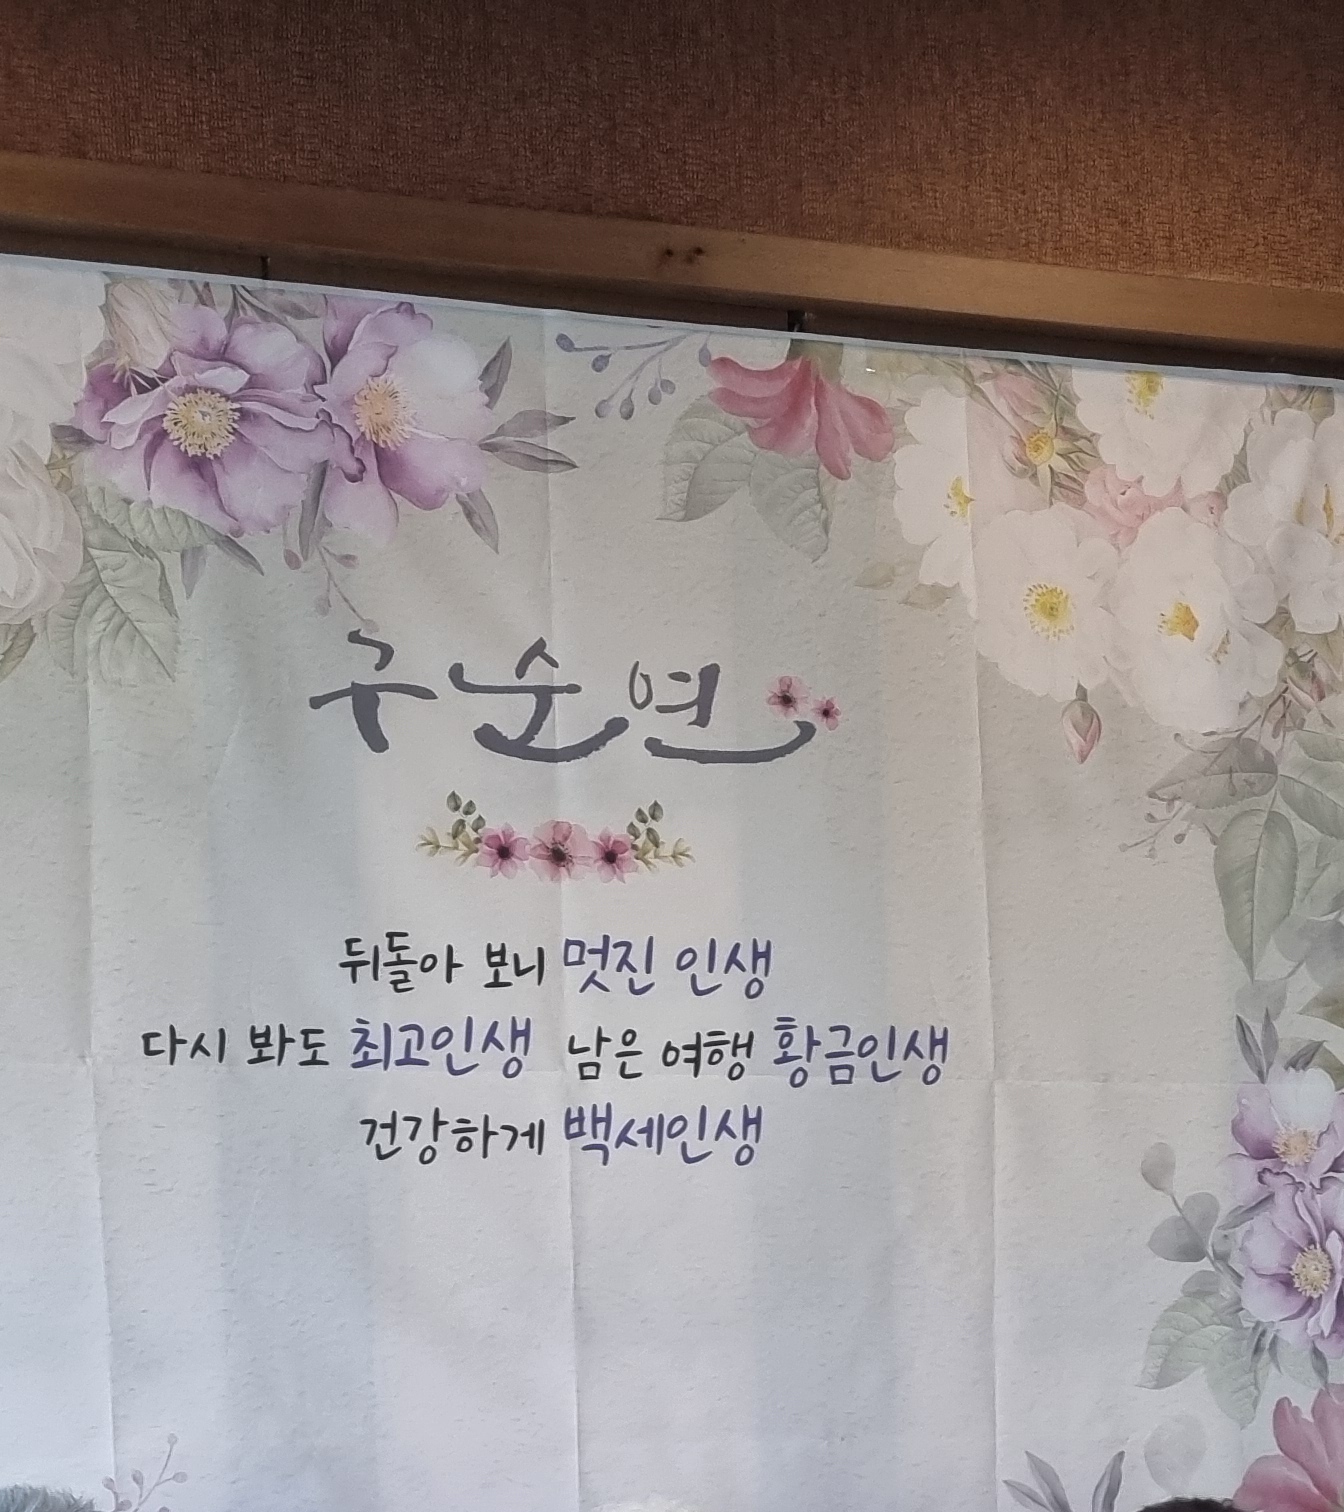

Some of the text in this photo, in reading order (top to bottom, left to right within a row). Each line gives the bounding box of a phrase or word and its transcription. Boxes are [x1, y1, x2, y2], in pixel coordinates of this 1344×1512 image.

[308, 628, 817, 764] 구순연
[338, 931, 772, 1000] 뒤돌아 보니 멋진 인생
[141, 1015, 949, 1087] 다시 봐도 최고인생 남은 여행 황금인생
[359, 1101, 763, 1167] 건강하게 백세인생
